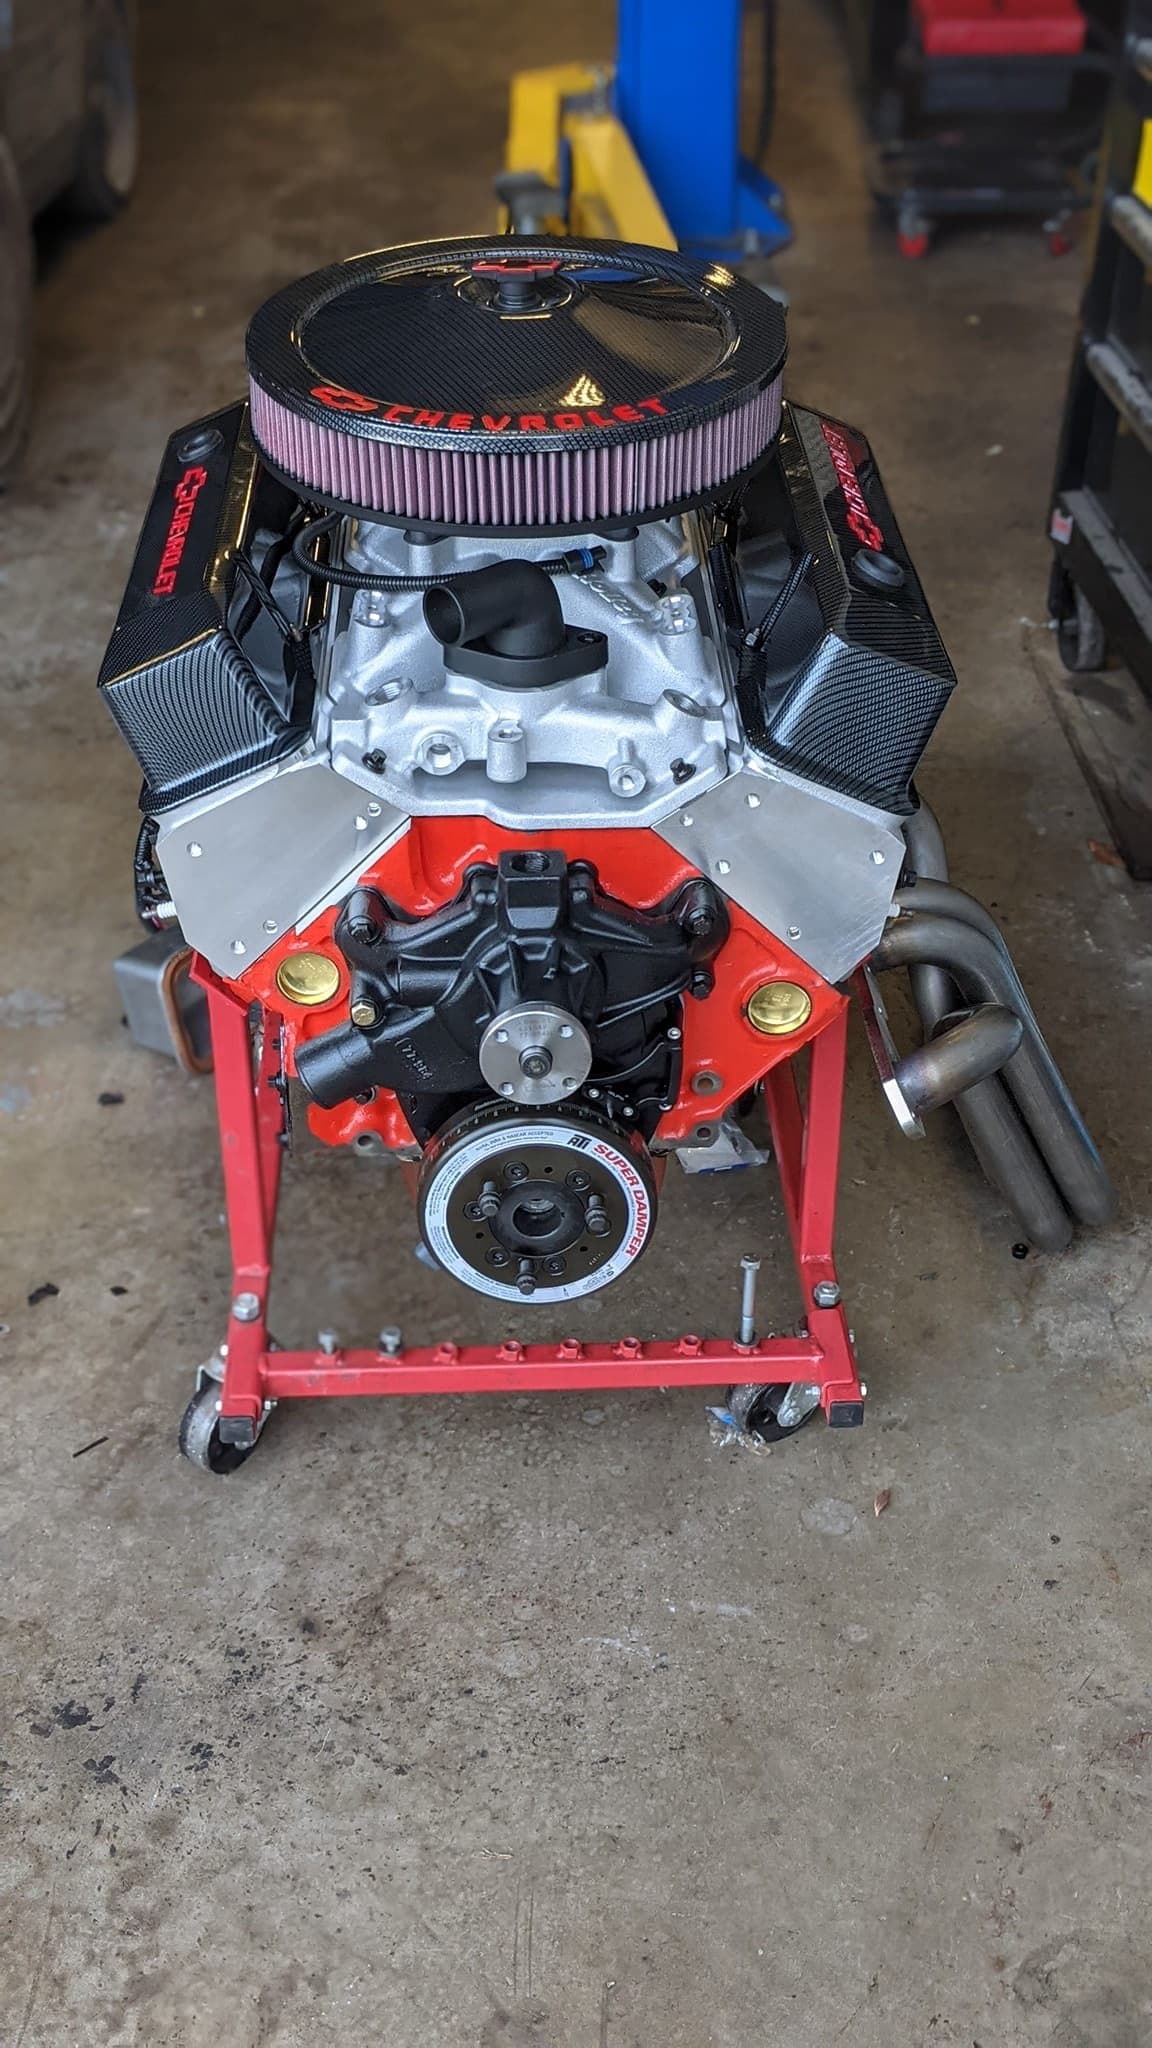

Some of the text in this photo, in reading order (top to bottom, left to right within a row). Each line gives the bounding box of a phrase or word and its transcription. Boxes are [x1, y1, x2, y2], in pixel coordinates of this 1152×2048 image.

[381, 398, 670, 431] CHEVROLET
[152, 502, 195, 597] CHEVROLET
[567, 1134, 592, 1150] ATI
[593, 1144, 640, 1187] SUPER
[625, 1190, 648, 1258] DAMPER
